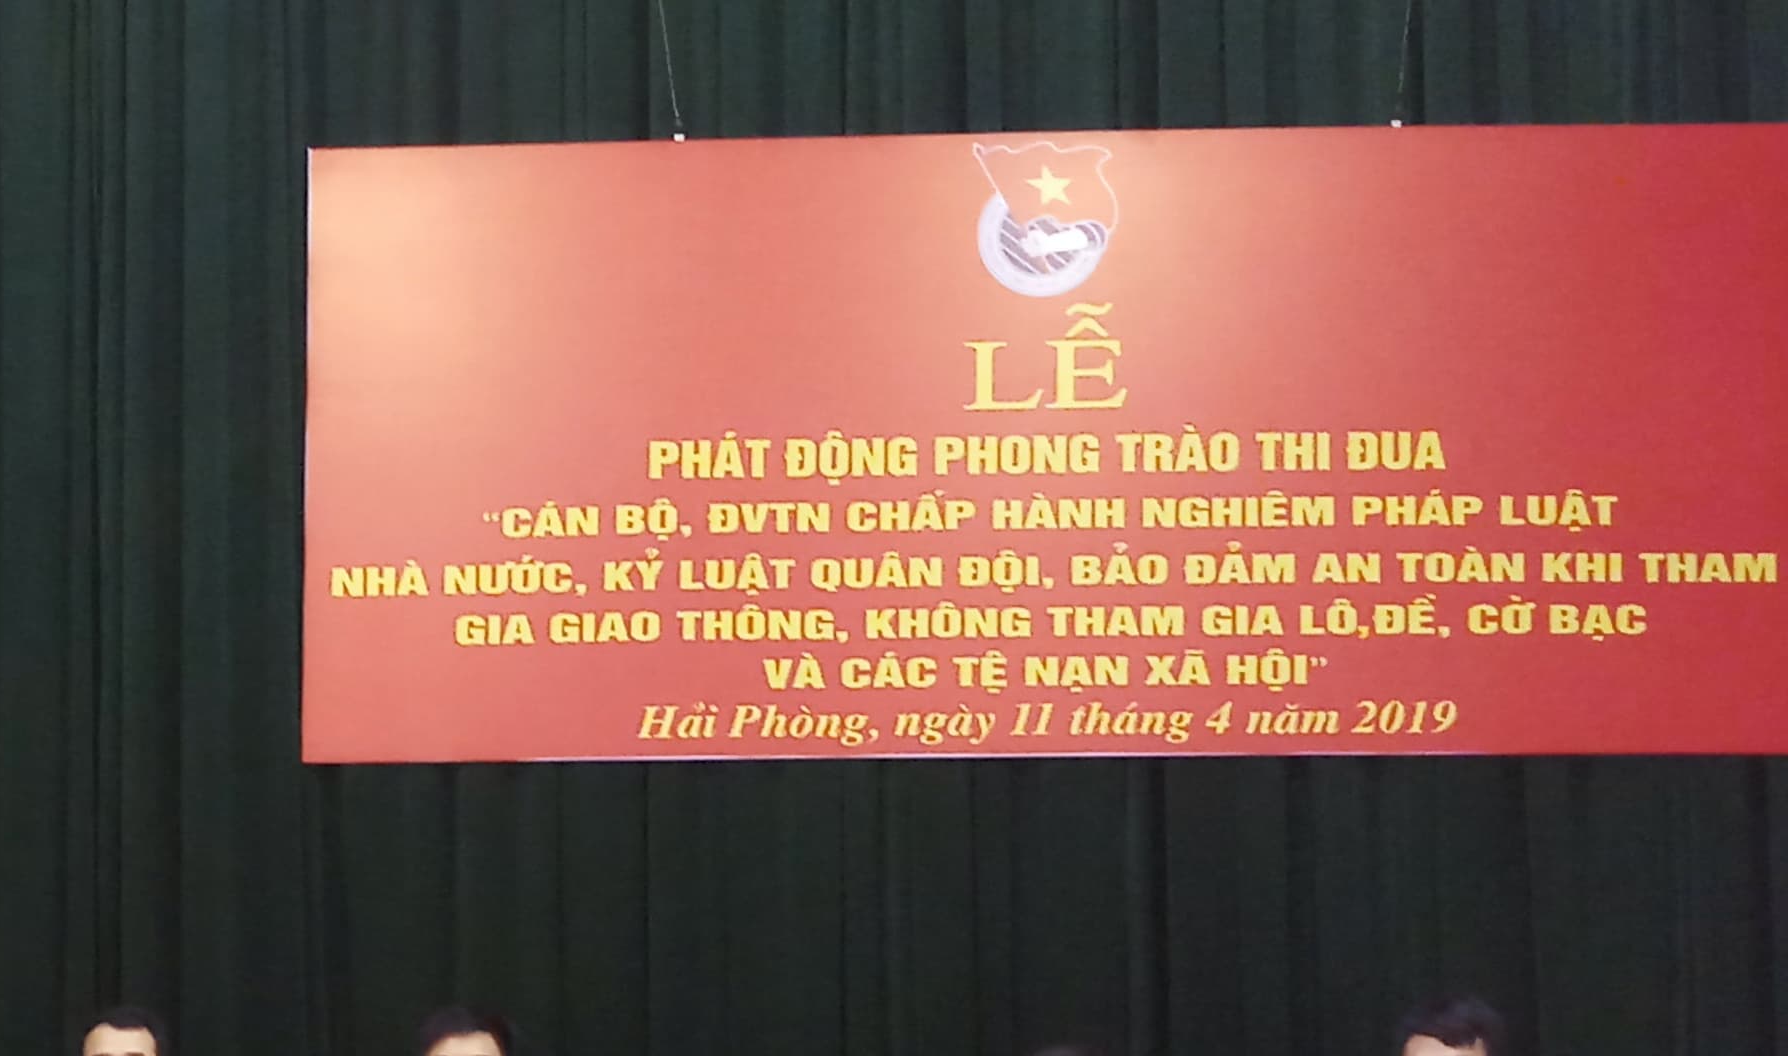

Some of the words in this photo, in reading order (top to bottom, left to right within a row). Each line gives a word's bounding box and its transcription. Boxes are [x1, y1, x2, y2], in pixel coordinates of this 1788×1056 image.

[963, 302, 1128, 410] LỄ
[648, 429, 772, 479] PHÁT
[784, 430, 918, 486] ĐỘNG
[934, 433, 1101, 476] PHONG
[1114, 424, 1240, 473] TRÀO
[1255, 431, 1331, 471] THI
[1346, 431, 1446, 471] ĐUA
[615, 497, 692, 541] BỘ,
[707, 502, 830, 533] ĐVTN
[847, 489, 977, 532] CHẤP
[992, 492, 1125, 530] HÀNH
[1142, 490, 1335, 529] NGHIÊM
[1352, 489, 1483, 526] PHÁP
[1499, 489, 1618, 532] LUẬT
[331, 559, 429, 597] NHÀ
[443, 554, 587, 596] NƯỚC,
[603, 547, 664, 591] KỶ
[679, 552, 796, 596] LUẬT
[811, 550, 943, 592] QUÂN
[958, 549, 1054, 593] ĐỘI,
[1071, 542, 1169, 585] BẢO
[1183, 541, 1296, 585] ĐẢM
[1312, 552, 1381, 584] AN
[1395, 545, 1525, 583] TOÀN
[1542, 552, 1623, 583] KHI
[1638, 552, 1777, 584] THAM
[455, 614, 535, 646] GIA
[550, 611, 660, 644] GIAO
[676, 603, 849, 643] THÔNG,
[865, 601, 1031, 639] KHÔNG
[1046, 605, 1185, 637] THAM
[1201, 605, 1284, 636] GIA
[1468, 594, 1537, 635] CỜ
[1549, 604, 1647, 642] BẠC
[762, 652, 826, 690] VÀ
[841, 651, 938, 689] CÁC
[952, 650, 1008, 694] TỆ
[1024, 655, 1129, 693] NẠN
[1145, 649, 1211, 686] XÃ
[638, 701, 719, 739] Hải
[728, 704, 879, 747] Phòng,
[894, 703, 996, 745] ngày
[1010, 703, 1054, 736] 11
[1070, 701, 1194, 744] tháng
[1205, 701, 1233, 734] 4
[1245, 703, 1339, 735] năm
[1351, 700, 1457, 734] 2019
